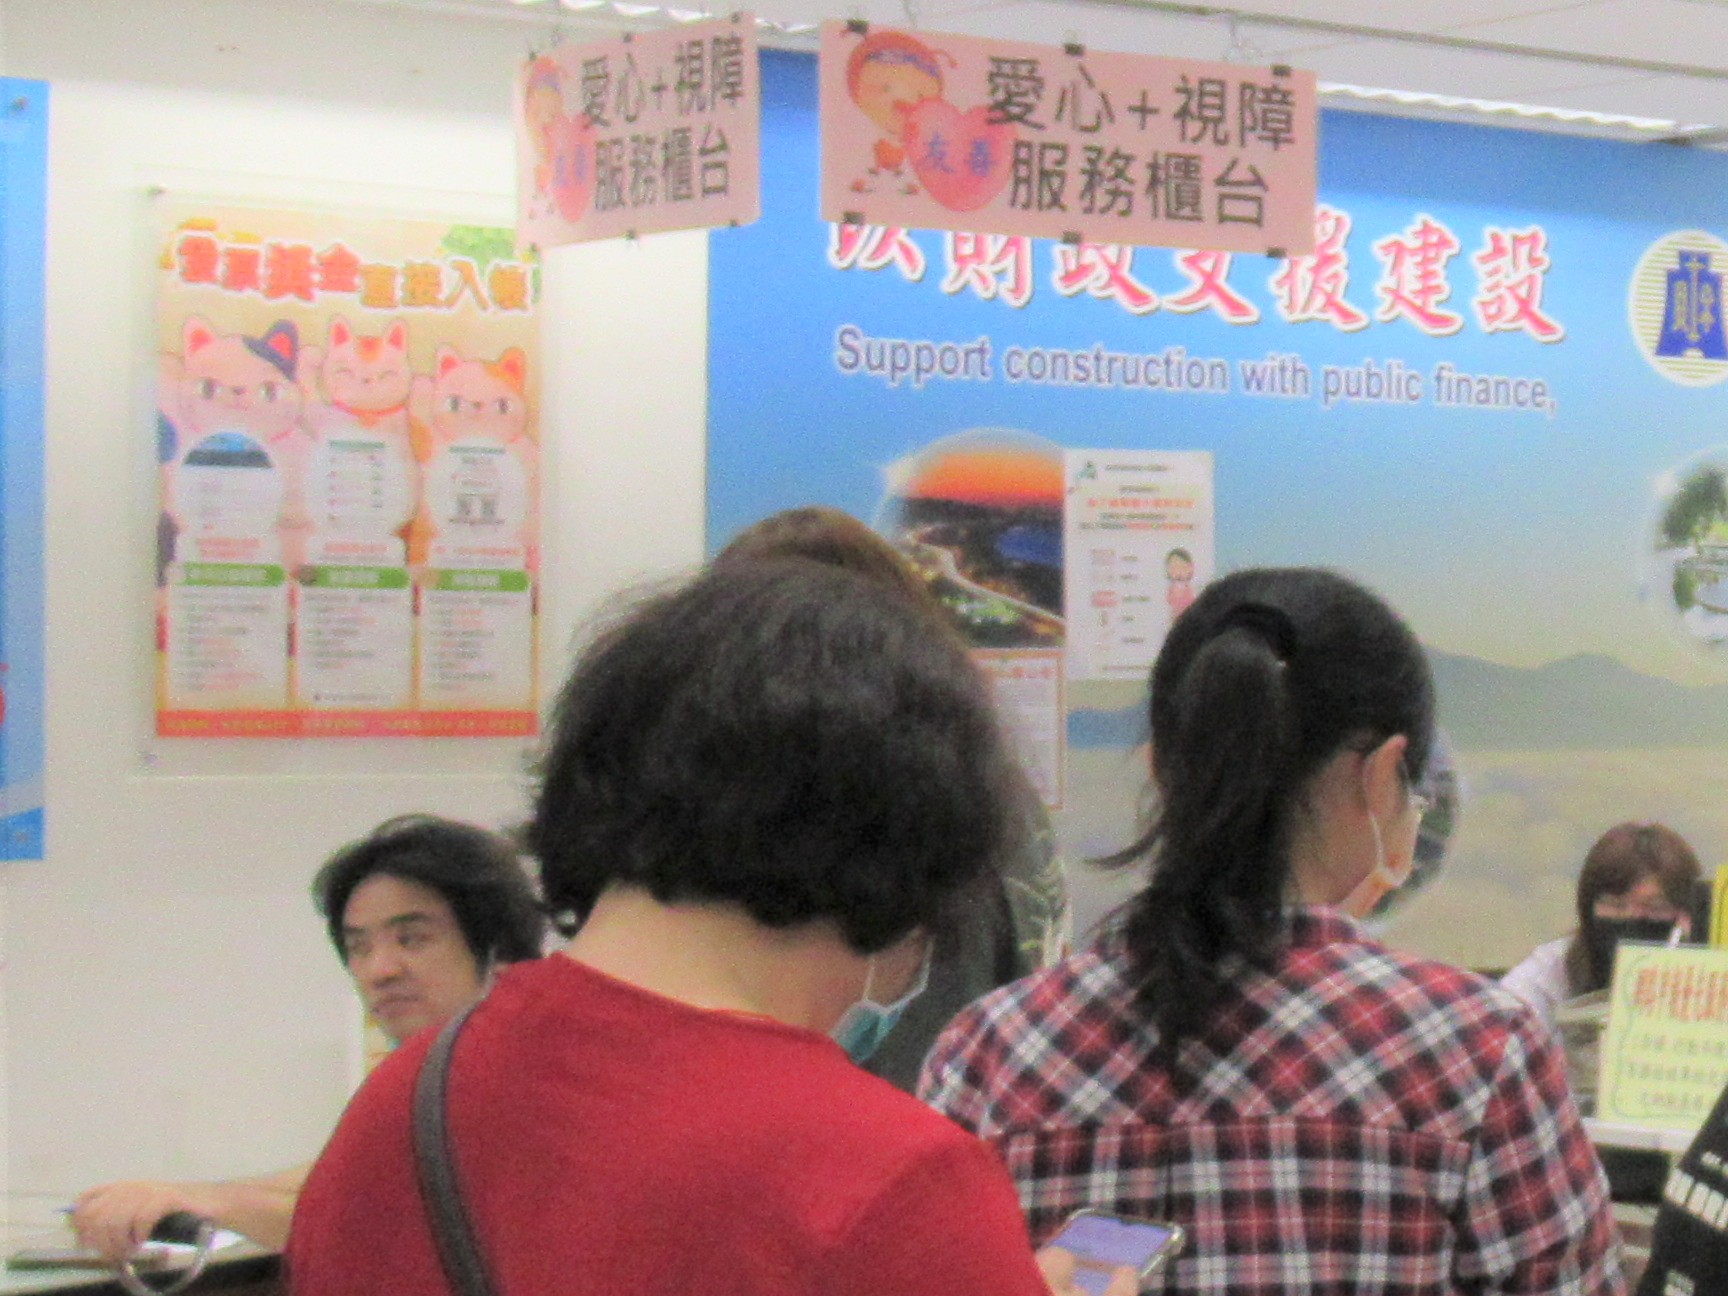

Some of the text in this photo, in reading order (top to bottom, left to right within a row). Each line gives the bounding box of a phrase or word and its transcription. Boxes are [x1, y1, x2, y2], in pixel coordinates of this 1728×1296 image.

[984, 55, 1296, 152] 愛心+視障
[1008, 138, 1269, 230] 服務櫃台
[836, 324, 990, 382] Support
[1005, 342, 1228, 392] construction
[1240, 359, 1310, 397] with
[1322, 364, 1422, 408] public
